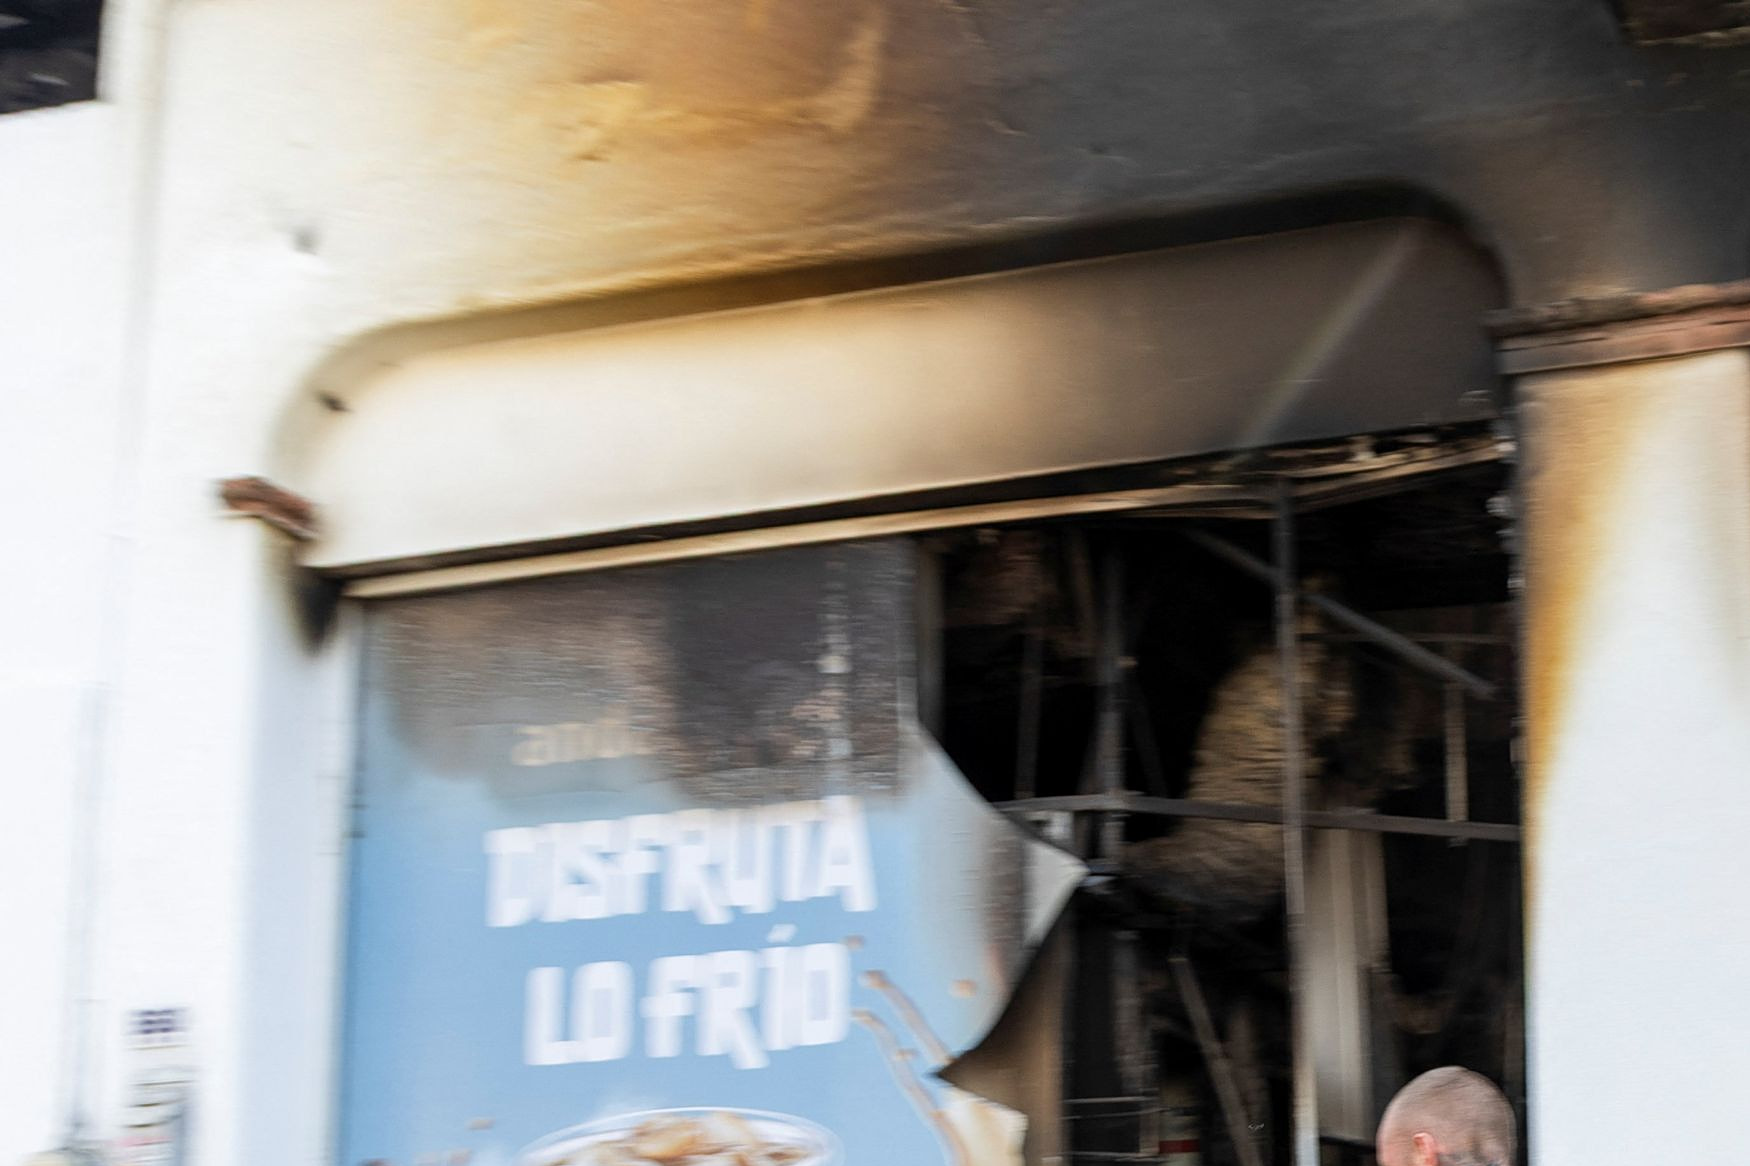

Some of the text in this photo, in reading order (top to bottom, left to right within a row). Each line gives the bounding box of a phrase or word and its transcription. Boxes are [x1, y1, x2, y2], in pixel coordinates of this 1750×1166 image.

[484, 797, 877, 927] DISFRUTA
[524, 924, 851, 1070] LO FRÍO
